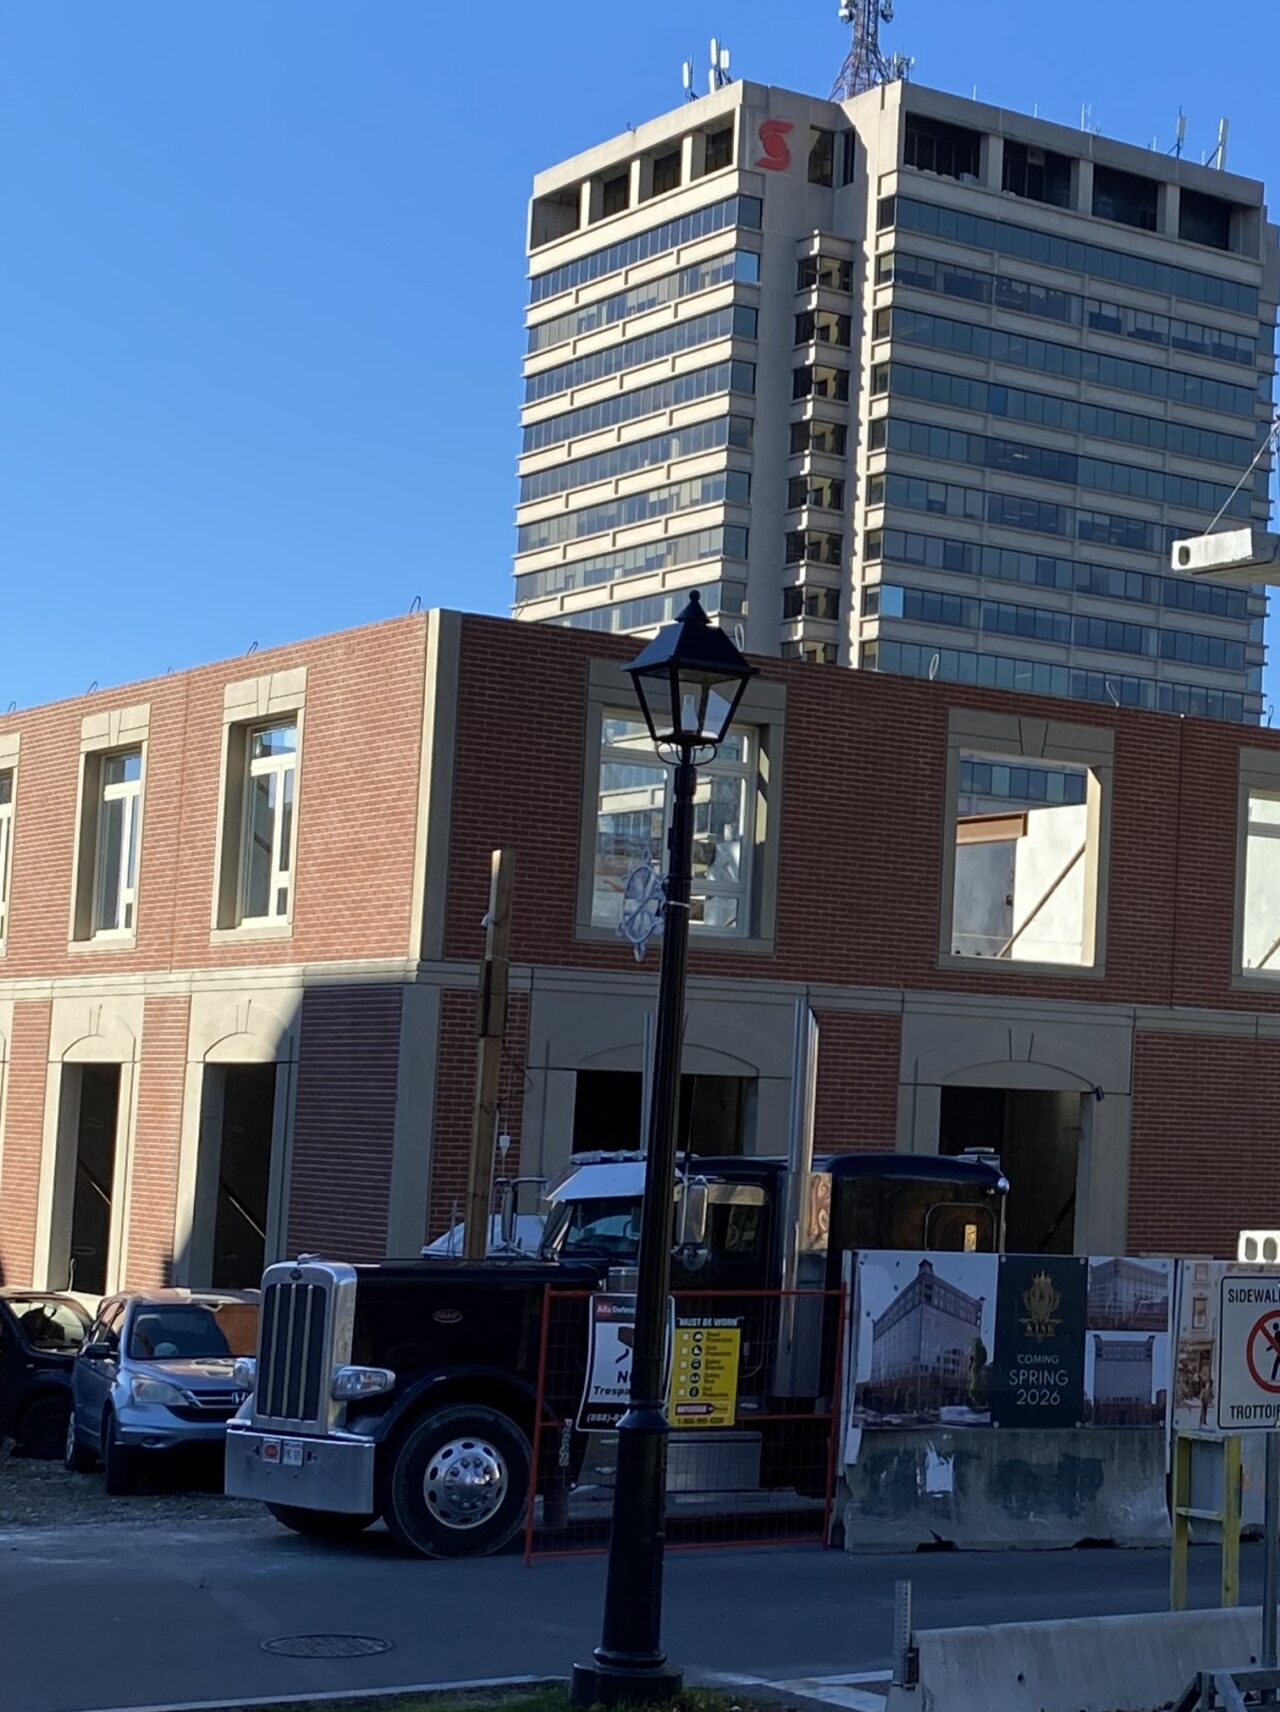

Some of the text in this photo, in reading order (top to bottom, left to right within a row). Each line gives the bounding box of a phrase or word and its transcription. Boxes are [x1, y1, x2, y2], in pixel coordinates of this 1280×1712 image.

[680, 1318, 701, 1327] MUST
[1016, 1353, 1060, 1365] COMING
[617, 1369, 631, 1384] N
[1009, 1368, 1069, 1387] SPRING
[592, 1385, 631, 1398] Trespa
[1016, 1389, 1061, 1406] 2026
